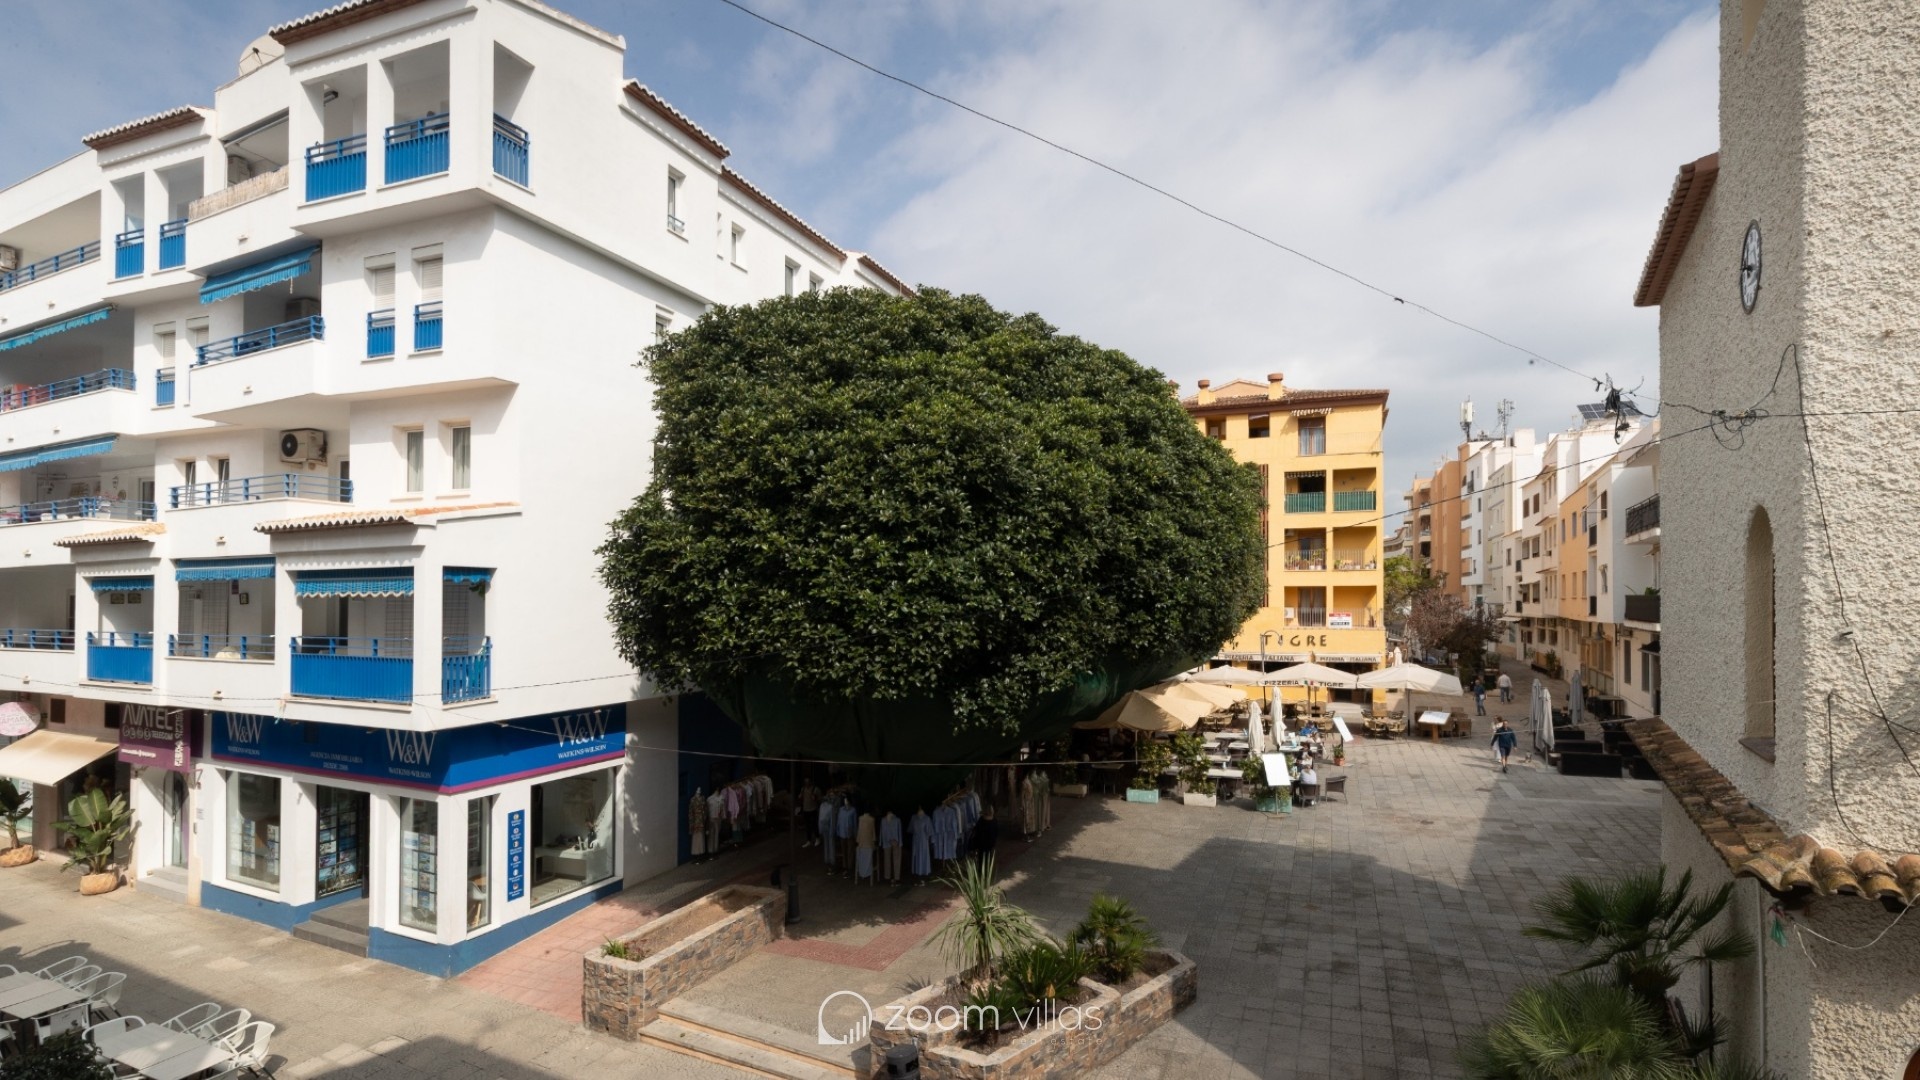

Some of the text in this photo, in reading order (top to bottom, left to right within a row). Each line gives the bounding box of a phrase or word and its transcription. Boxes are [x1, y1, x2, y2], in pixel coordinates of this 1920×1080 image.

[122, 703, 174, 731] AVATEL
[225, 712, 264, 744] W&W
[552, 709, 610, 747] W&W
[386, 729, 436, 765] W&W
